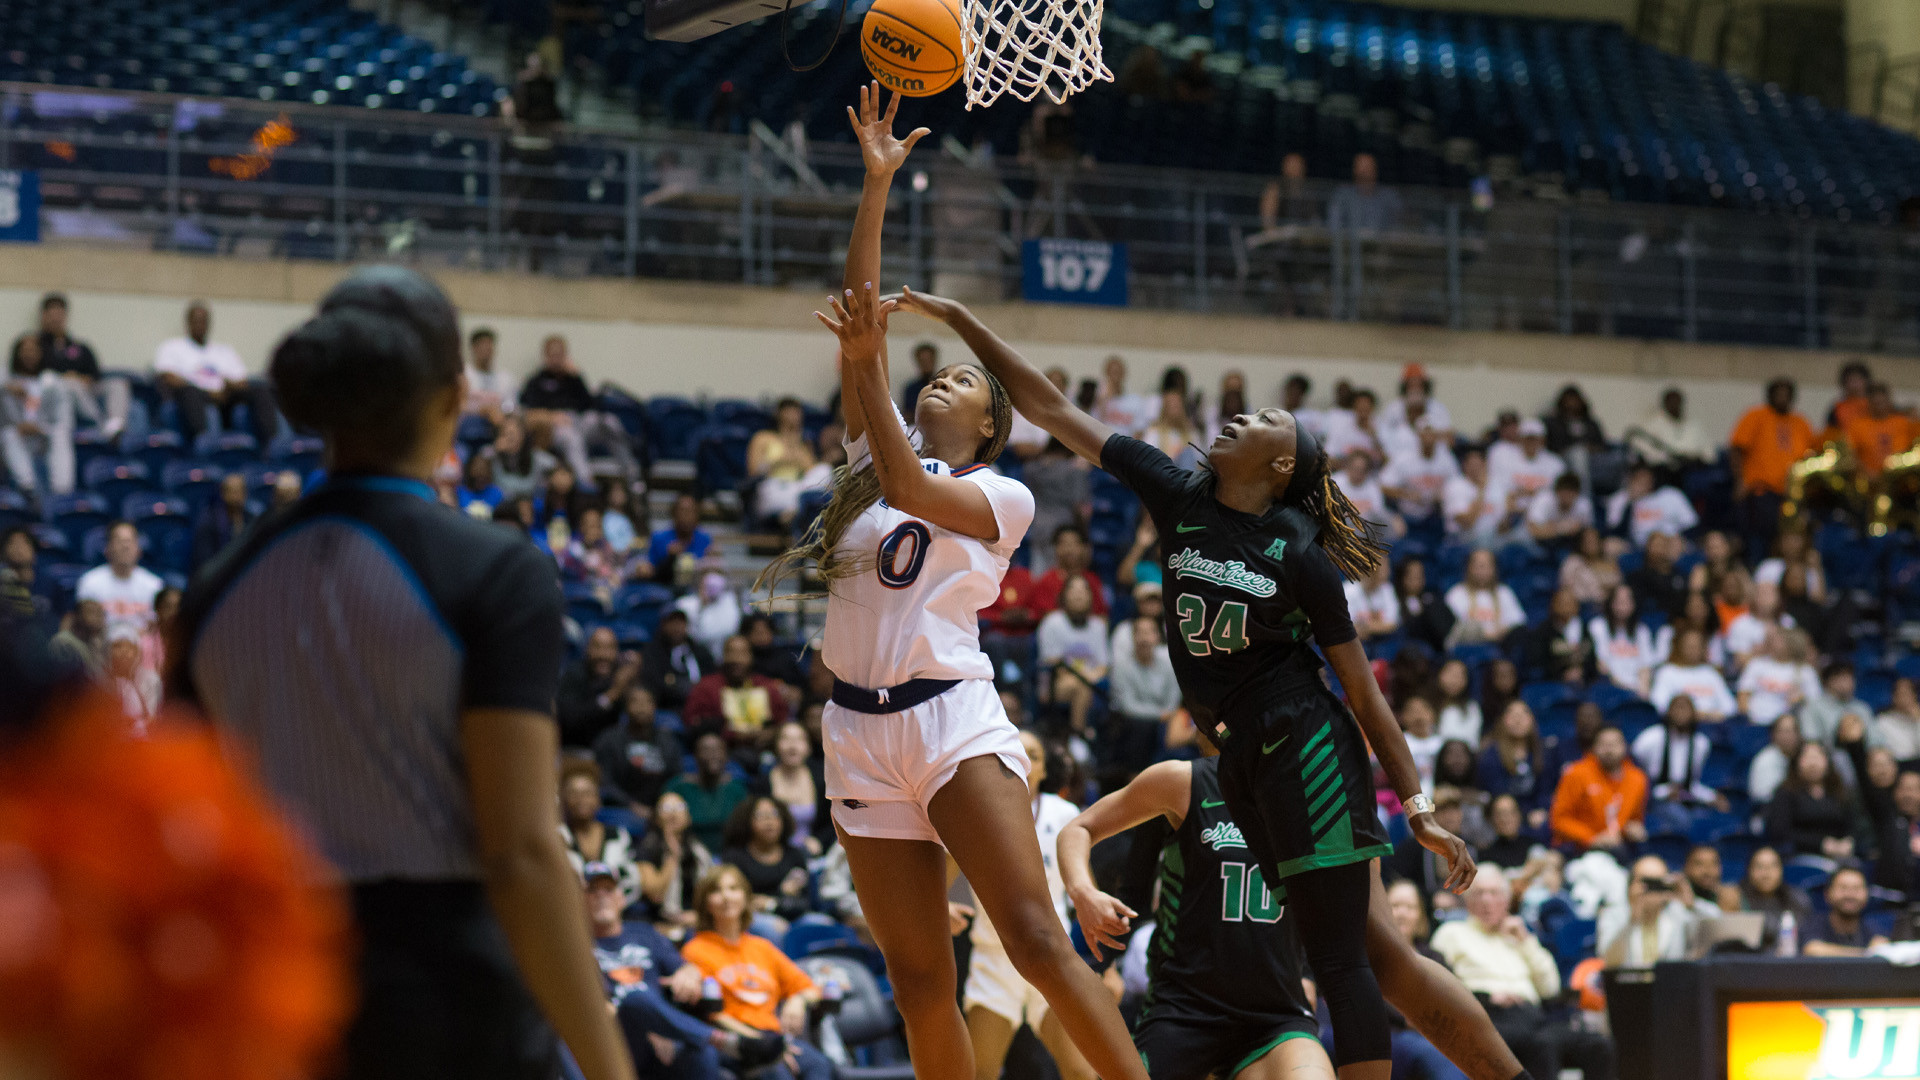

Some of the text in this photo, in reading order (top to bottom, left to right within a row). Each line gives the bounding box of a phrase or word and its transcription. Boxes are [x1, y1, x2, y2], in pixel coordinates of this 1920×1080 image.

[871, 25, 922, 62] NCAA
[1040, 255, 1110, 292] 107
[876, 520, 932, 590] 0
[1168, 547, 1277, 596] Mean Green
[1176, 592, 1250, 656] 24
[1201, 821, 1246, 845] Me
[1221, 861, 1284, 923] 10
